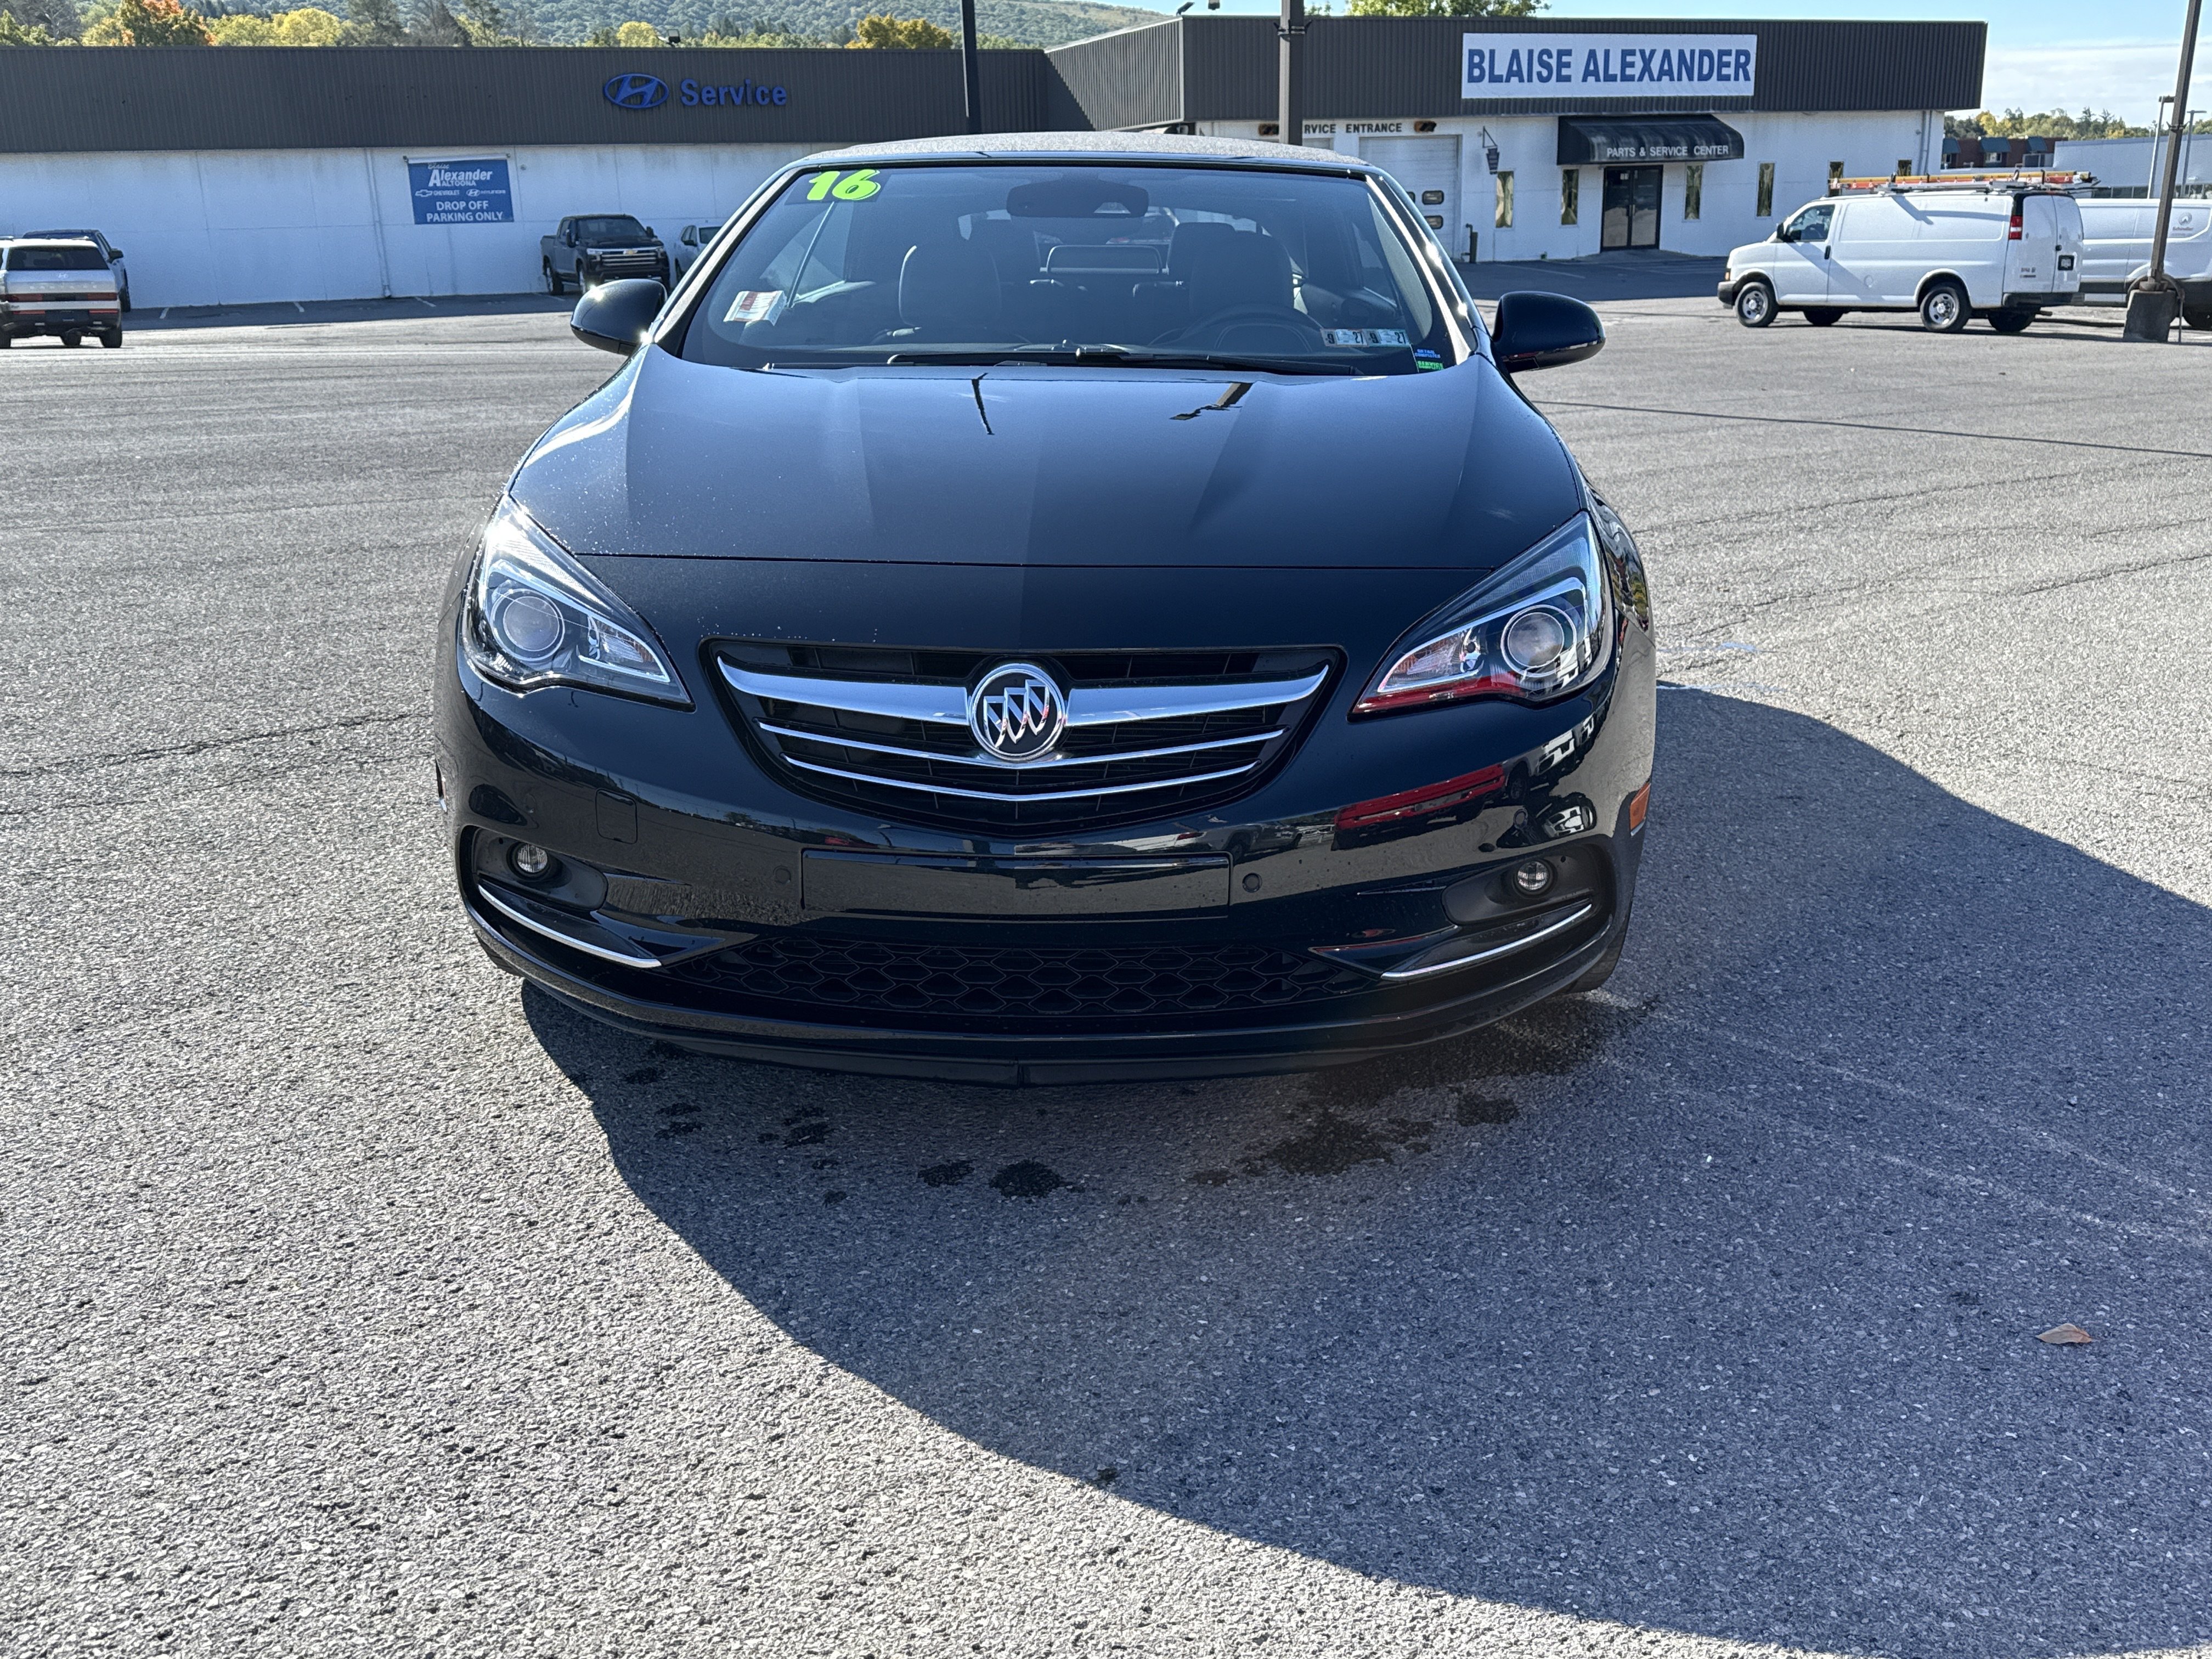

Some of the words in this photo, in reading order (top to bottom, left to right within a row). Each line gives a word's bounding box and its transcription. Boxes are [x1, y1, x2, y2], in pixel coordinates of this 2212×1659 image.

[1468, 48, 1572, 83] BLAISE
[1582, 48, 1751, 82] ALEXANDER
[680, 78, 786, 106] Service
[1304, 123, 1336, 134] RVICE
[1346, 123, 1402, 133] ENTRANCE
[1607, 147, 1636, 157] PARTS
[1639, 147, 1646, 156] &
[1650, 146, 1688, 156] SERVICE
[1694, 145, 1729, 155] CENTER
[428, 169, 493, 187] Alexander
[806, 169, 881, 201] 16
[436, 201, 466, 210] DROP
[469, 200, 488, 209] OFF
[426, 212, 473, 222] PARKING
[475, 211, 503, 221] ONLY
